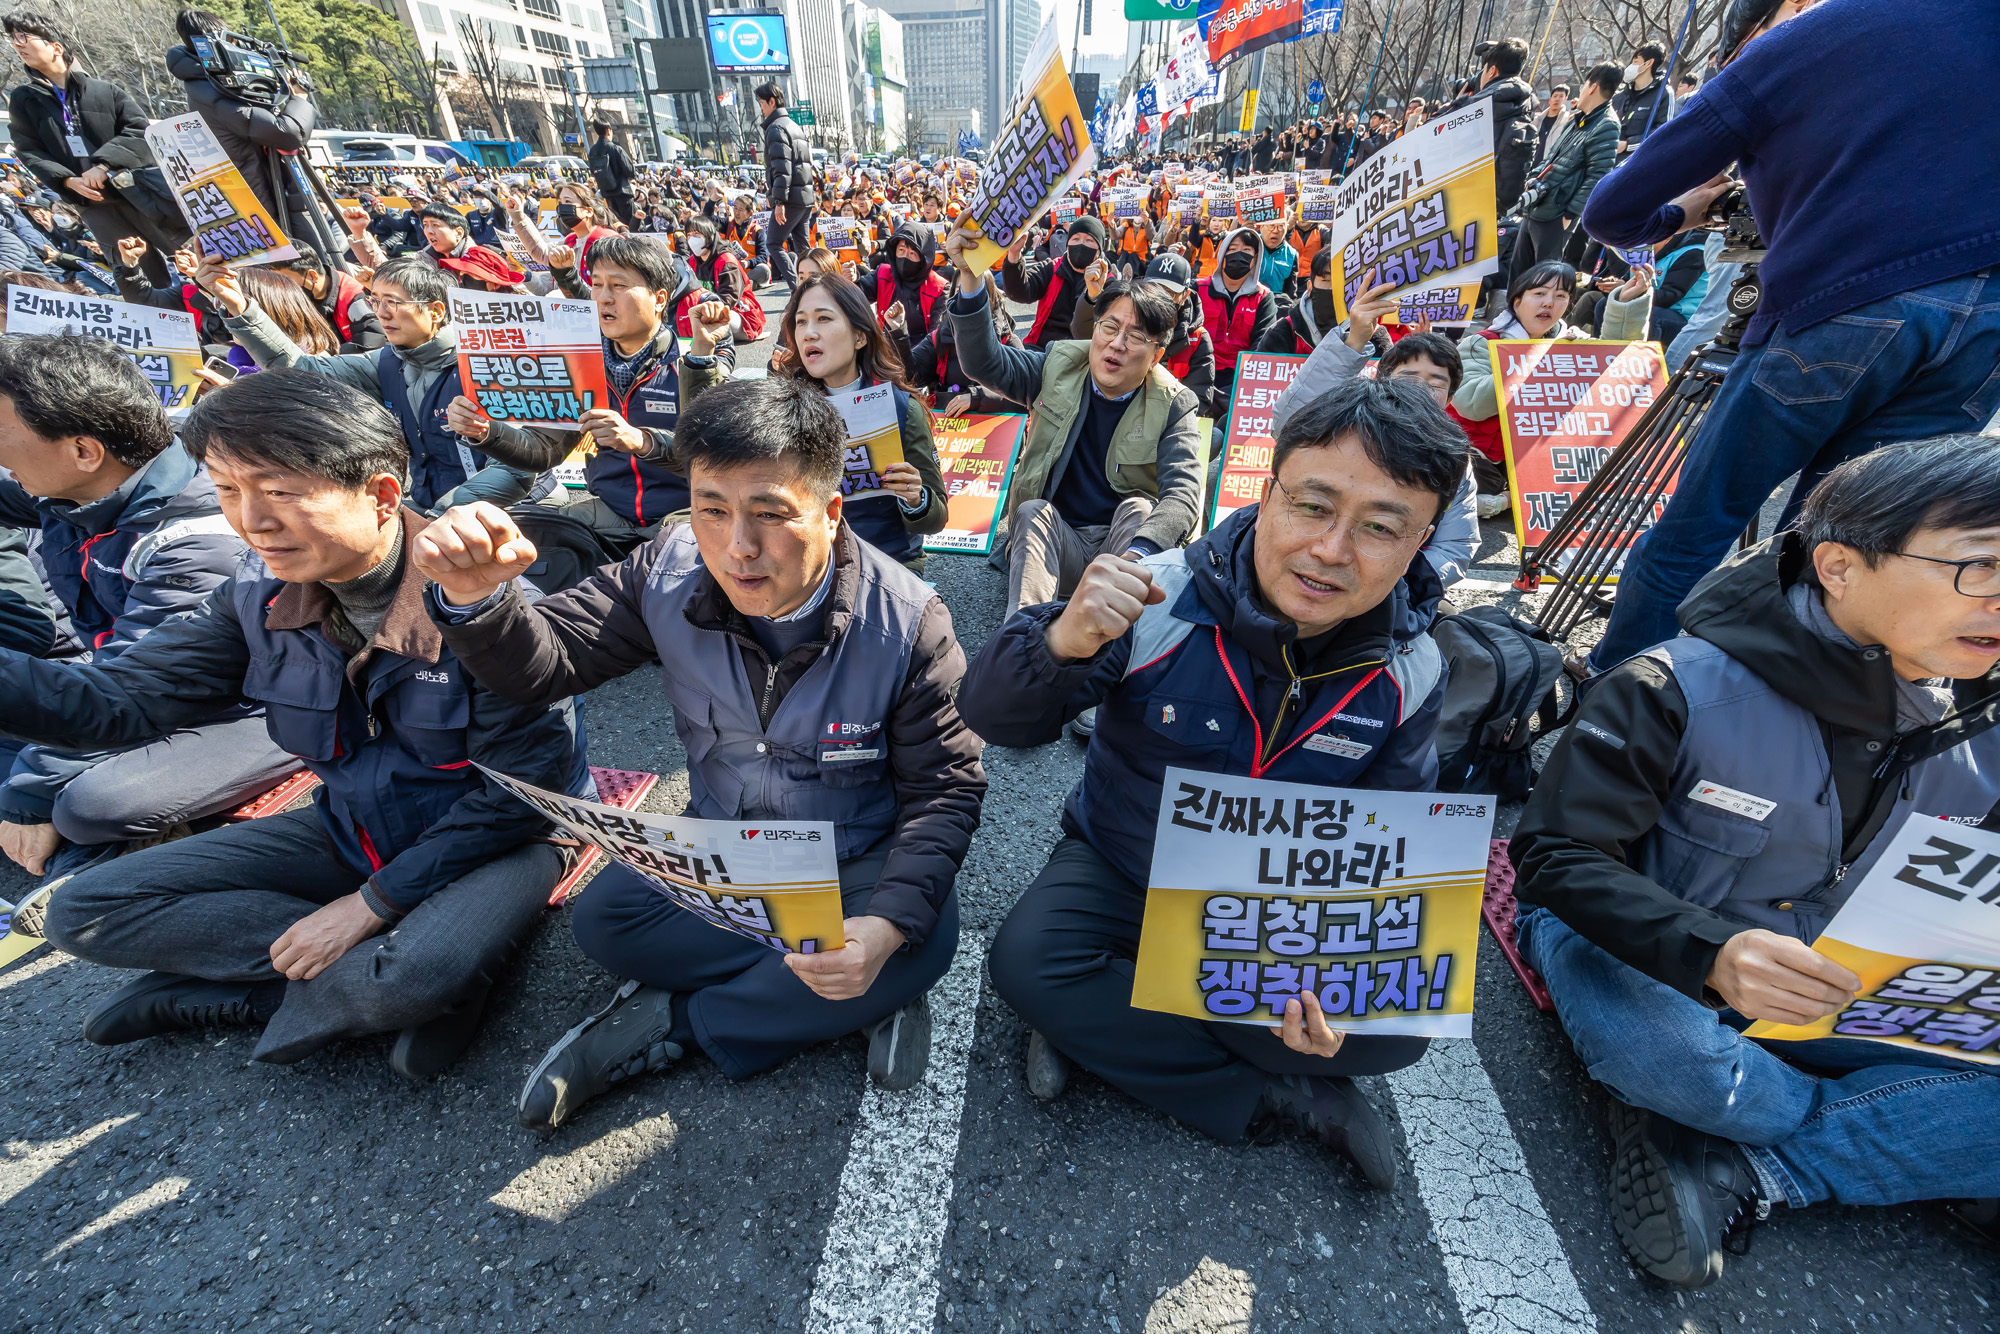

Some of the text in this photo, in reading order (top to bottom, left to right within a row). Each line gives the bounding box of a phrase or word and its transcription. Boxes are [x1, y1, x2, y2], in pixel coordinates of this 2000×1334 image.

[1447, 107, 1484, 131] 민주노총
[980, 115, 1079, 248] 쟁취하자!
[1234, 176, 1269, 191] 모든 노동자의
[1236, 187, 1261, 201] 노동기본권
[1335, 154, 1387, 220] 진짜사장
[1356, 158, 1425, 230] 나와라!
[1342, 188, 1448, 281] 원청교섭
[1159, 257, 1175, 274] NY
[13, 290, 114, 325] 진짜사장
[168, 313, 192, 324] 민주노총
[452, 298, 545, 325] 모든 노동자의
[561, 304, 592, 314] 민주노총
[458, 328, 528, 351] 노동기본권
[468, 354, 573, 388] 투쟁으로
[1242, 359, 1272, 382] 법원
[1506, 353, 1654, 380] 사전통보 없이
[474, 388, 595, 422] 쟁취하자!
[863, 389, 888, 402] 민주노총
[1508, 381, 1655, 409] 1분만에 80명
[1514, 411, 1614, 437] 집단해고
[952, 458, 1005, 477] 매각했다.
[841, 721, 882, 735] 민주노총
[1170, 781, 1355, 841] 진짜사장
[1444, 803, 1487, 819] 민주노총
[763, 829, 822, 843] 민주노총
[1257, 836, 1407, 889] 나와라!
[1200, 893, 1424, 956] 원청교섭
[1196, 953, 1454, 1017] 쟁취하자!
[1831, 1000, 2000, 1052] 쟁취
